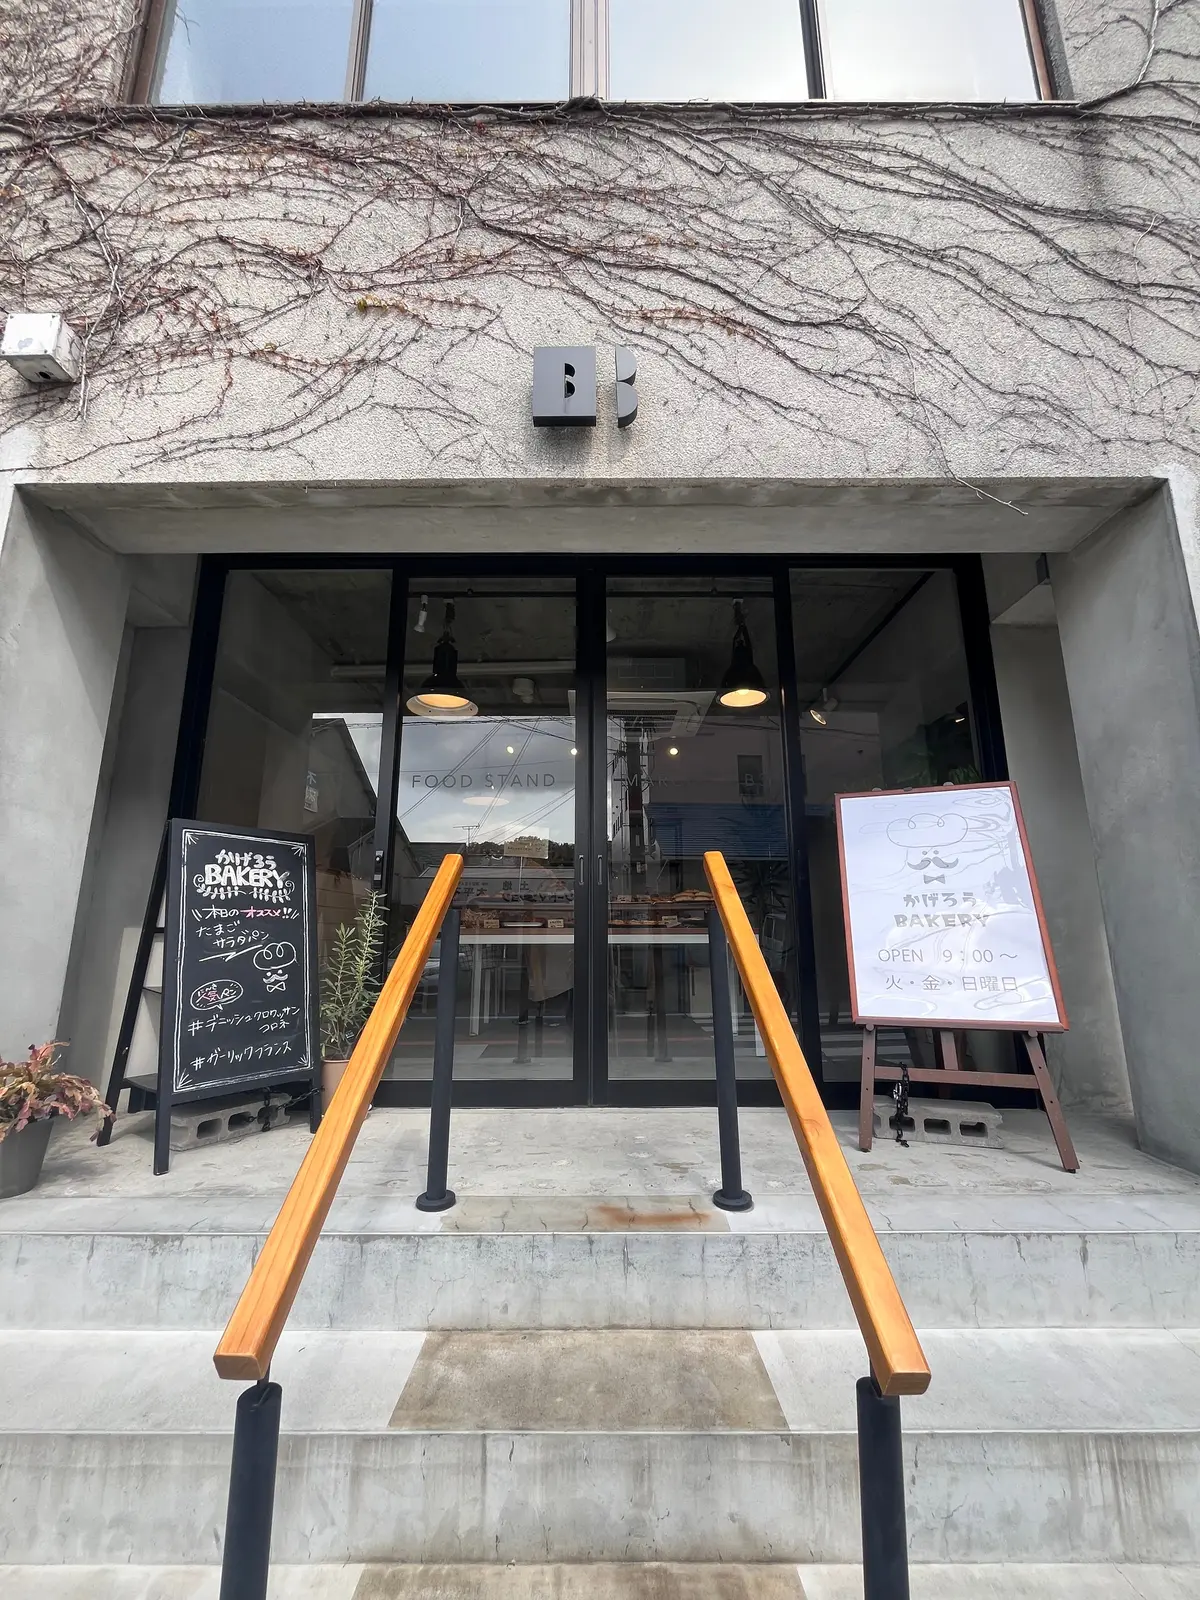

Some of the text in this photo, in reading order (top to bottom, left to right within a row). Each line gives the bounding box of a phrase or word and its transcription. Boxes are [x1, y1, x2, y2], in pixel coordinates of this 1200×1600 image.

[411, 773, 556, 789] FOOD STAND
[215, 849, 277, 870] かげろう
[204, 864, 290, 889] BAKERY
[903, 892, 977, 908] かげろう
[195, 919, 240, 938] たまご
[894, 913, 991, 928] BAKERY
[213, 929, 270, 949] サラダパン
[878, 949, 924, 963] OPEN
[259, 1018, 290, 1033] コロネ
